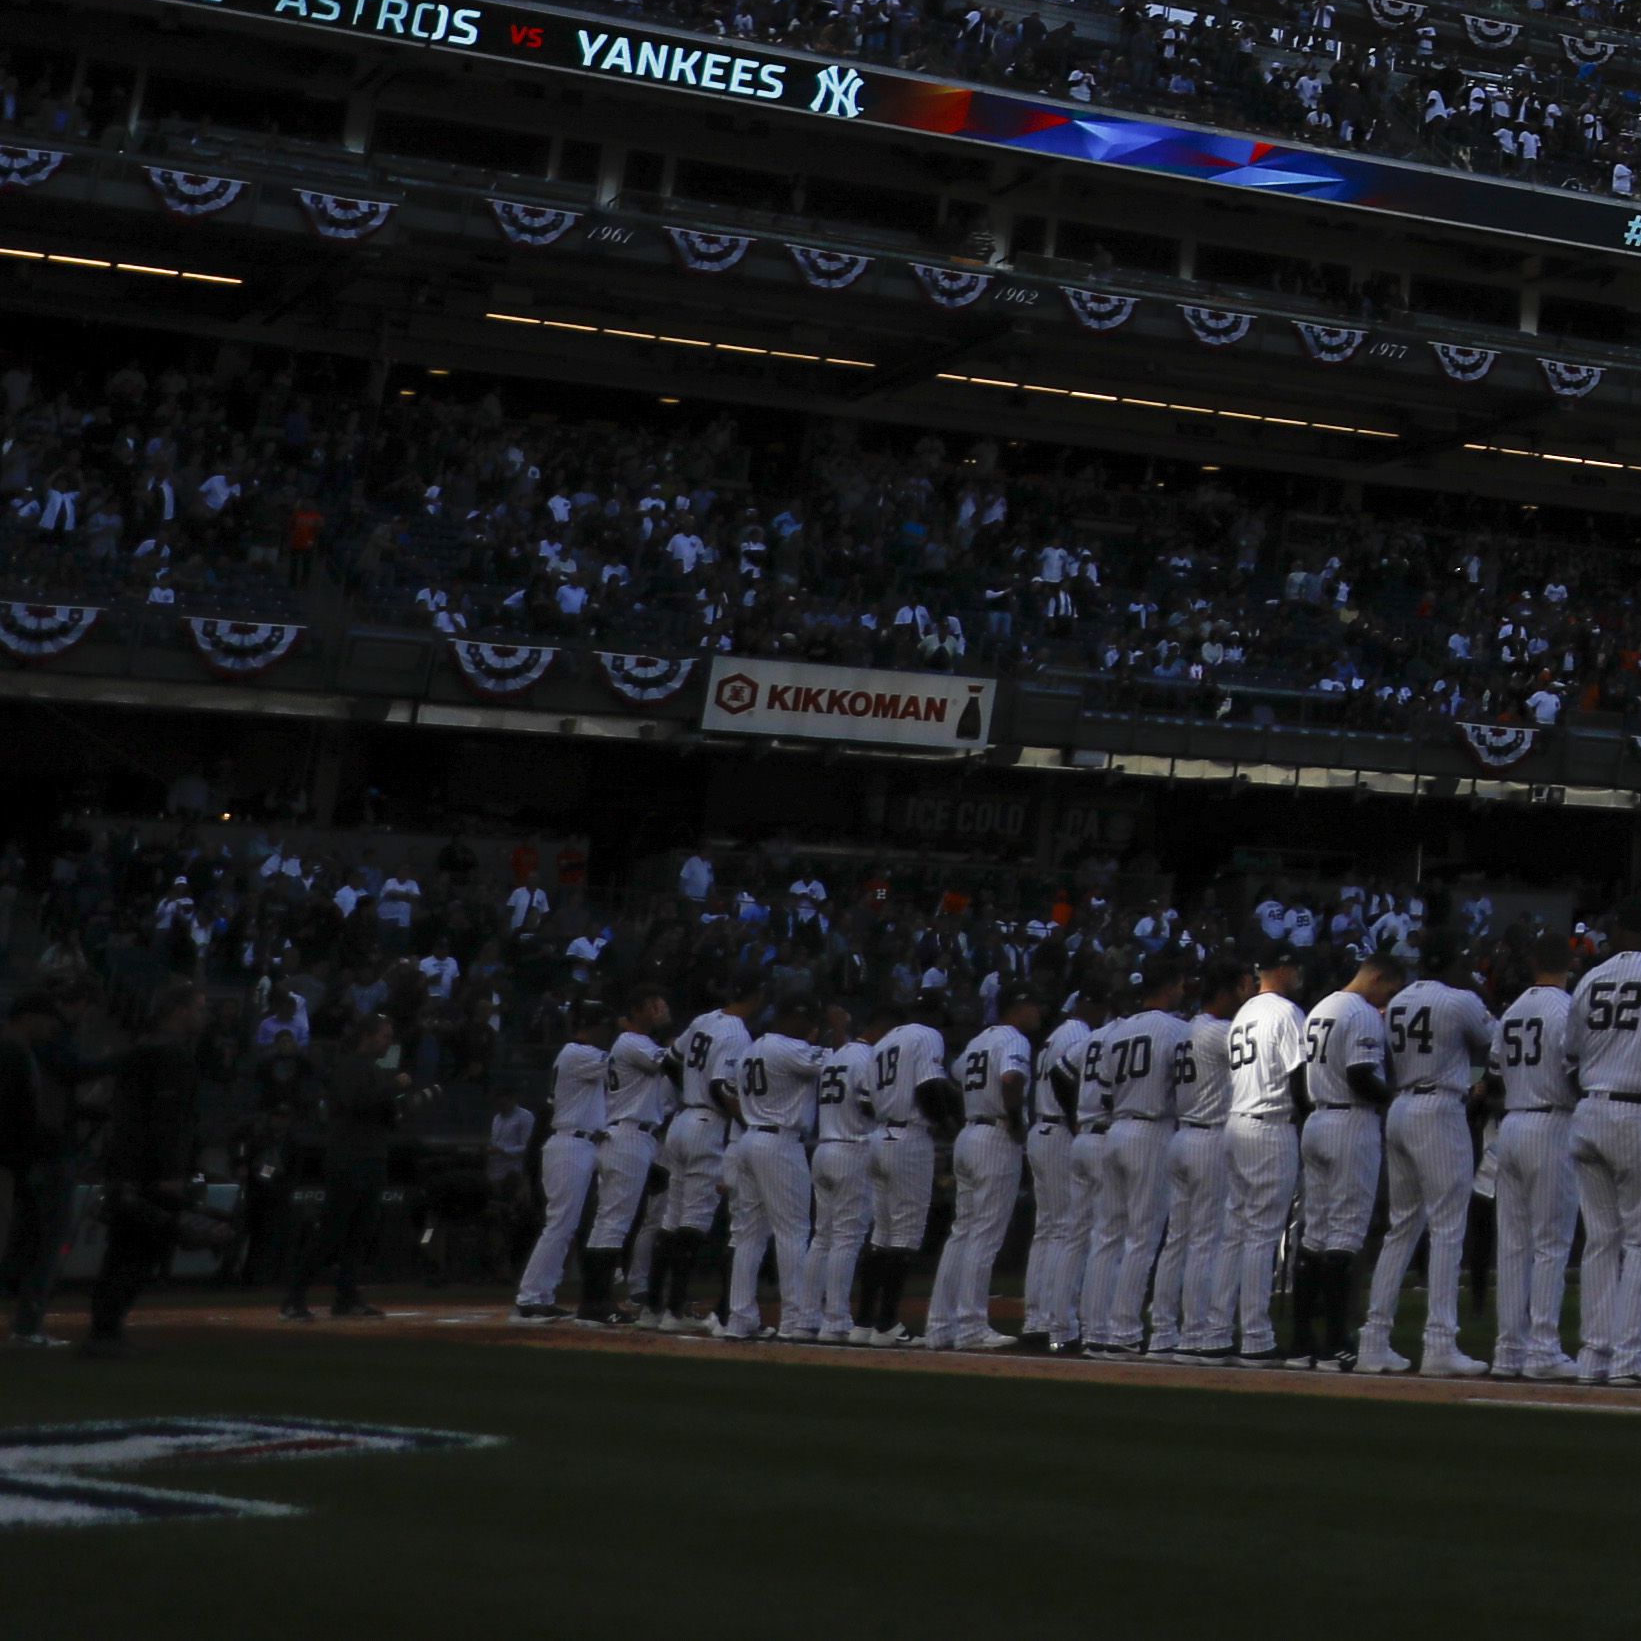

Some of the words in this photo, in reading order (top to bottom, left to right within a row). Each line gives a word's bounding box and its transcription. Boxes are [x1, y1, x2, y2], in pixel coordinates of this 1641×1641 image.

[577, 29, 787, 100] YANKEES
[587, 225, 635, 245] 1961
[993, 286, 1039, 306] 1962
[1368, 341, 1409, 360] 1977
[766, 683, 948, 723] KIKKOMAN
[1230, 1020, 1259, 1071] 65
[1306, 1017, 1337, 1064] 57
[1389, 1005, 1433, 1054] 54
[1502, 1016, 1544, 1067] 53
[743, 1057, 768, 1097] 30
[876, 1044, 901, 1091] 18
[1111, 1034, 1152, 1085] 70
[820, 1065, 848, 1105] 25
